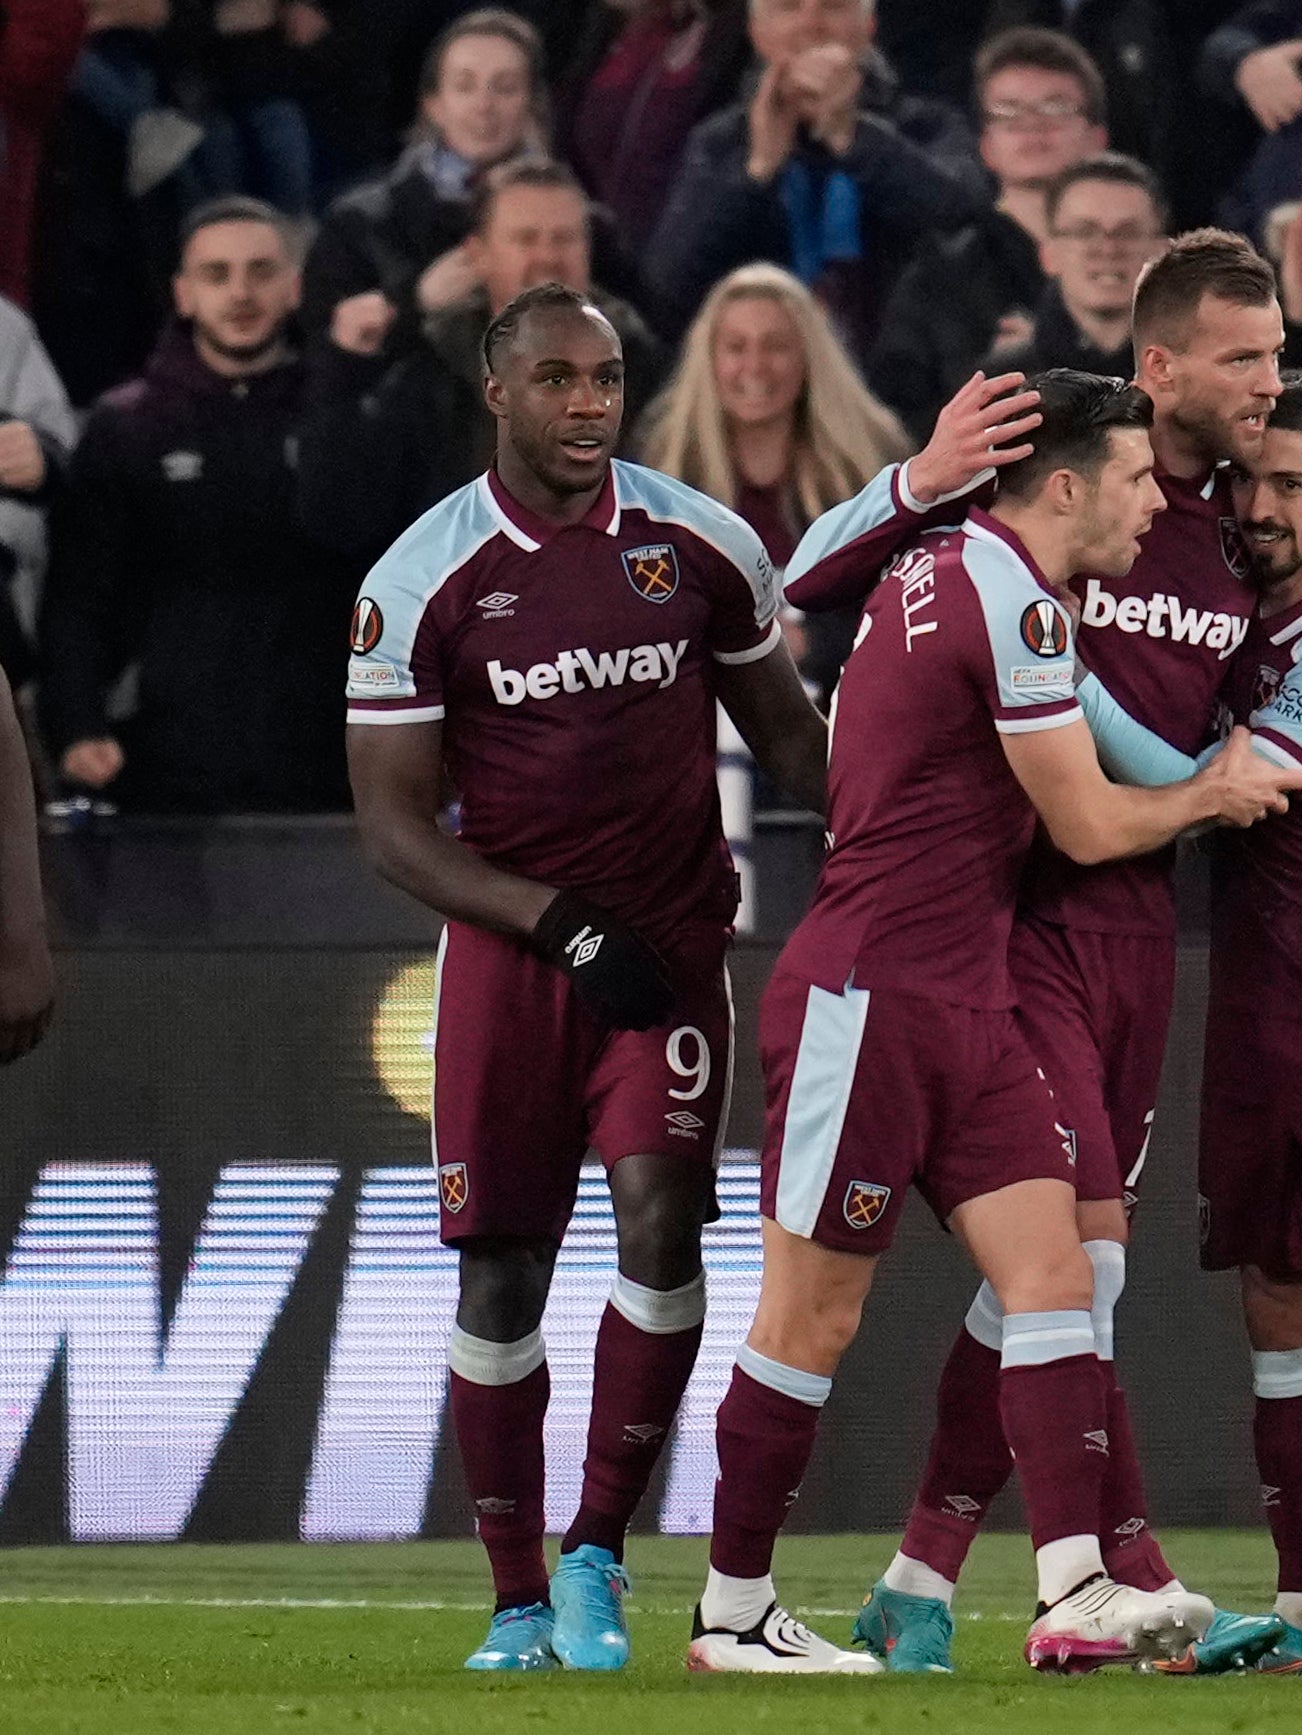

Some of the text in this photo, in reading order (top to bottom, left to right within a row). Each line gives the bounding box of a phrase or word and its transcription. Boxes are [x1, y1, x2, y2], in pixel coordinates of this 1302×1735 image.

[482, 608, 516, 620] umbro
[1081, 579, 1250, 661] betway
[486, 639, 690, 706] betway
[666, 1025, 711, 1101] 9
